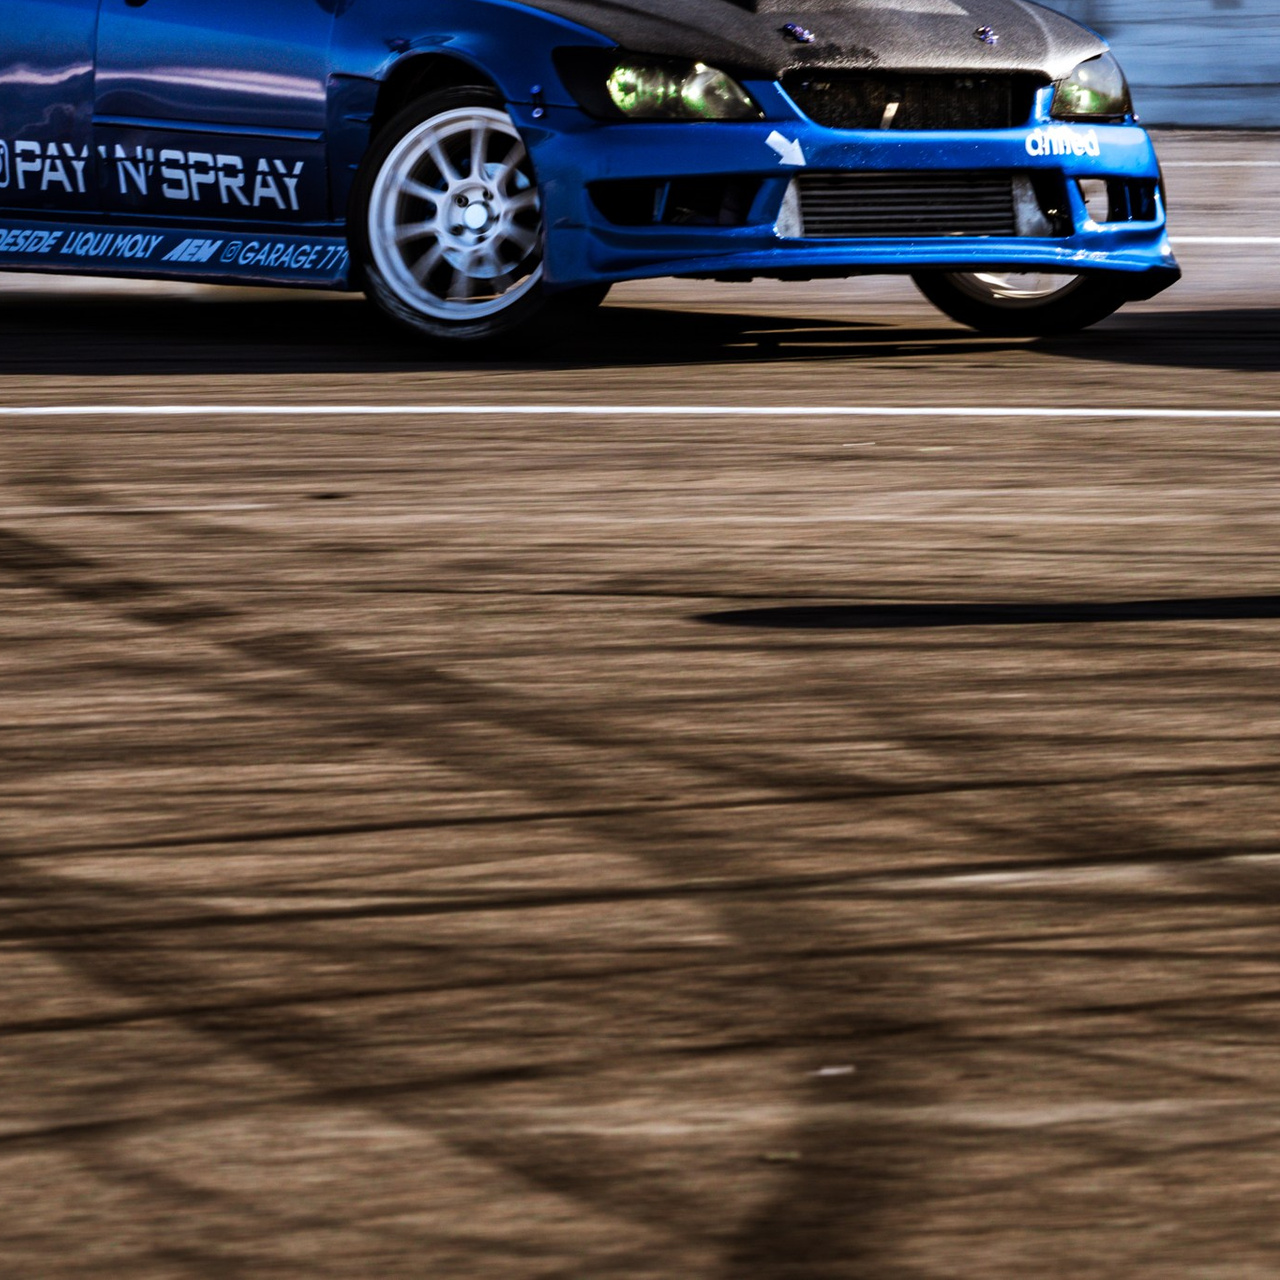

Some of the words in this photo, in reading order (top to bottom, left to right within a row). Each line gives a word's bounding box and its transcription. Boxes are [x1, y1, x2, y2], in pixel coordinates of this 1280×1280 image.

[15, 140, 88, 192] PAY
[160, 149, 304, 210] SPRAY
[60, 231, 114, 256] LIQUI
[107, 233, 164, 258] MOLY
[238, 241, 322, 268] GARAGE
